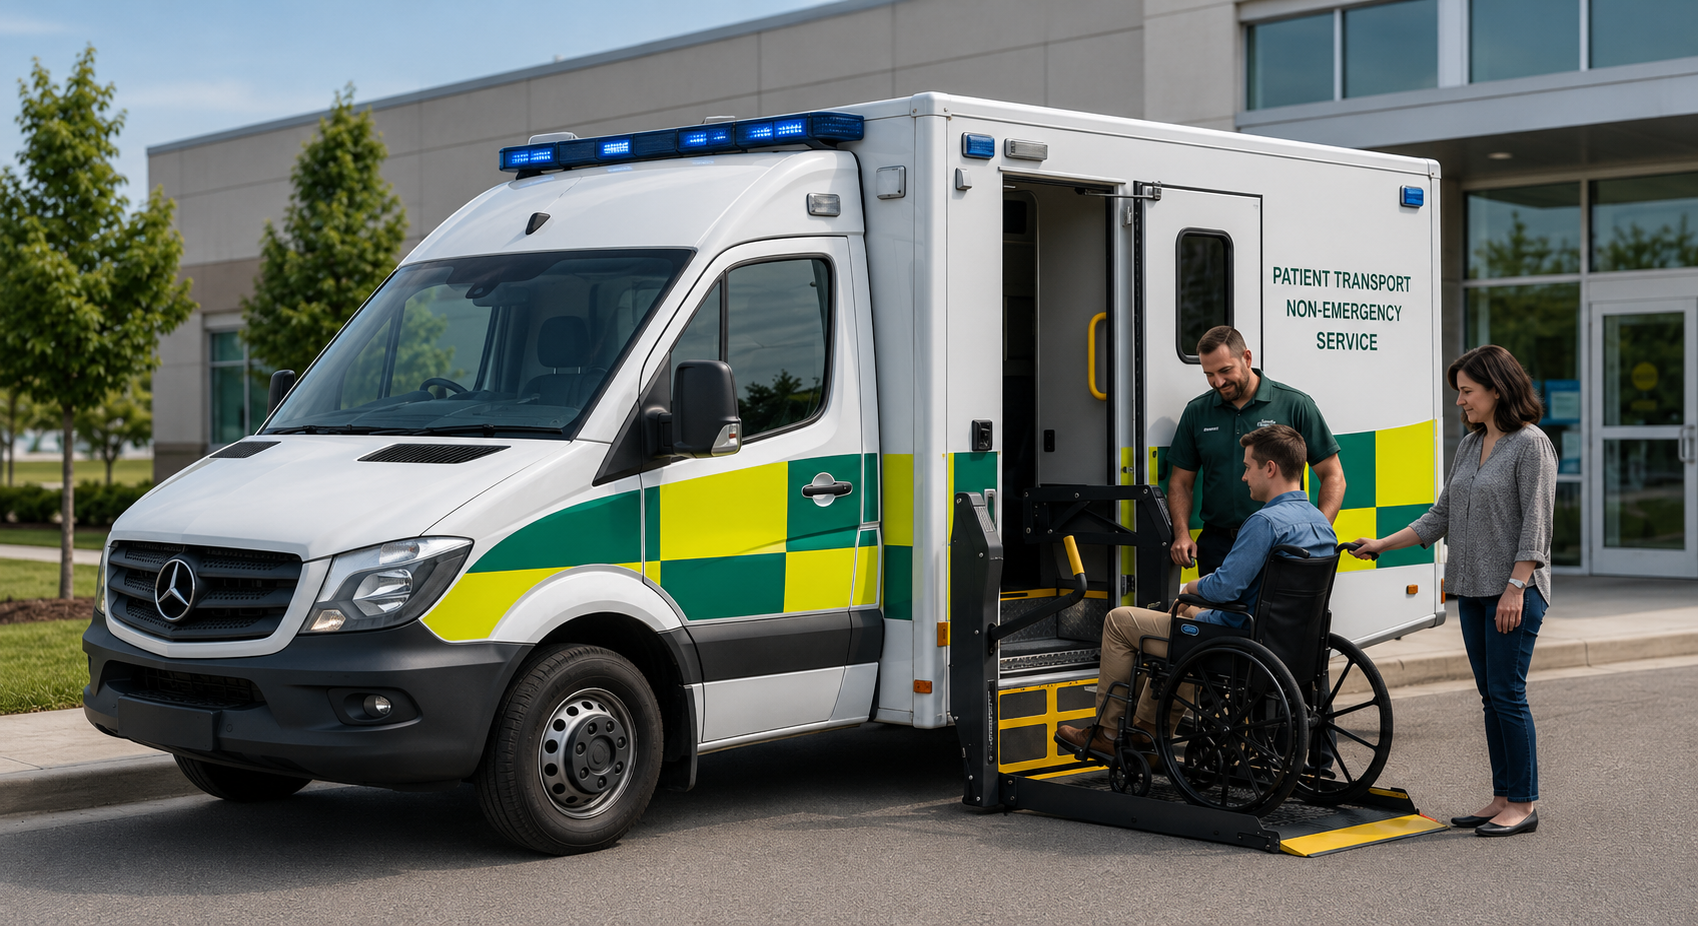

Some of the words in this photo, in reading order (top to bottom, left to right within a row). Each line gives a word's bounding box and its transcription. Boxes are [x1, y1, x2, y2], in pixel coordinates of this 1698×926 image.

[1273, 267, 1330, 287] PATIENT
[1334, 271, 1411, 292] TRANSPORT
[1287, 299, 1402, 321] NON-EMERGENCY
[1317, 332, 1377, 350] SERVICE
